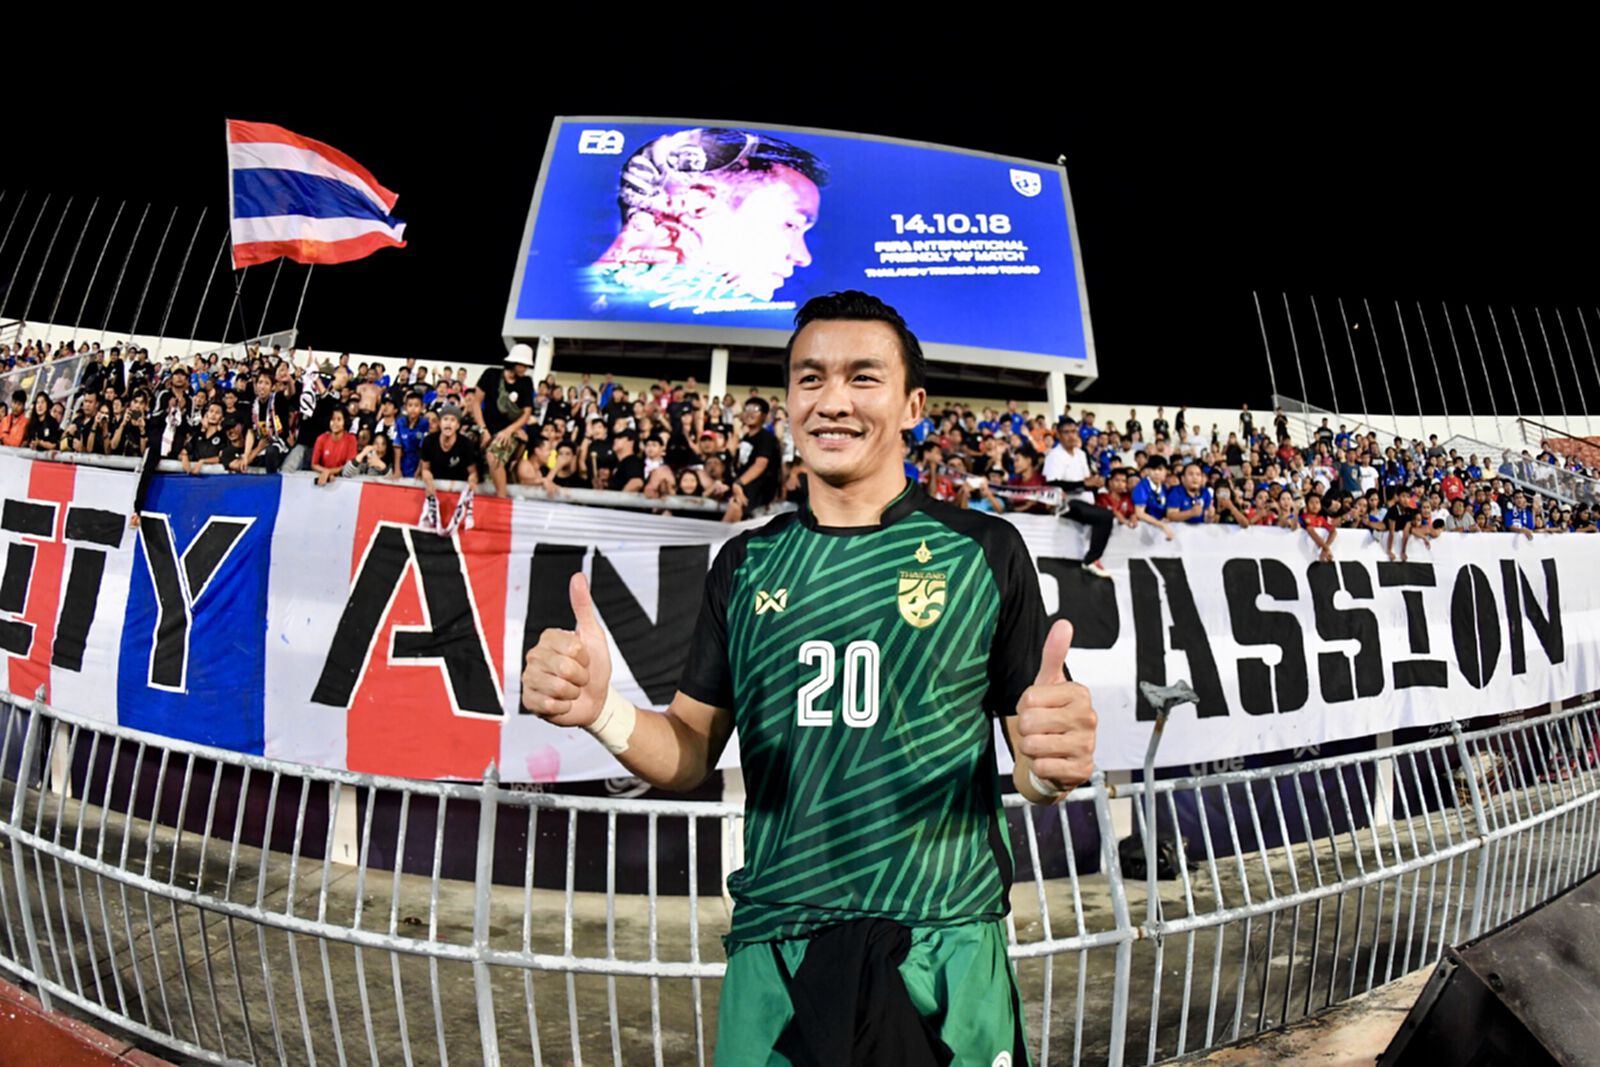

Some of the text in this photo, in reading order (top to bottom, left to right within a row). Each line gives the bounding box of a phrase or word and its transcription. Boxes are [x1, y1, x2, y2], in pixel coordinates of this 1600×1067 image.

[891, 214, 1012, 234] 14.10.18
[1037, 557, 1564, 721] PASSION
[797, 640, 880, 728] 20
